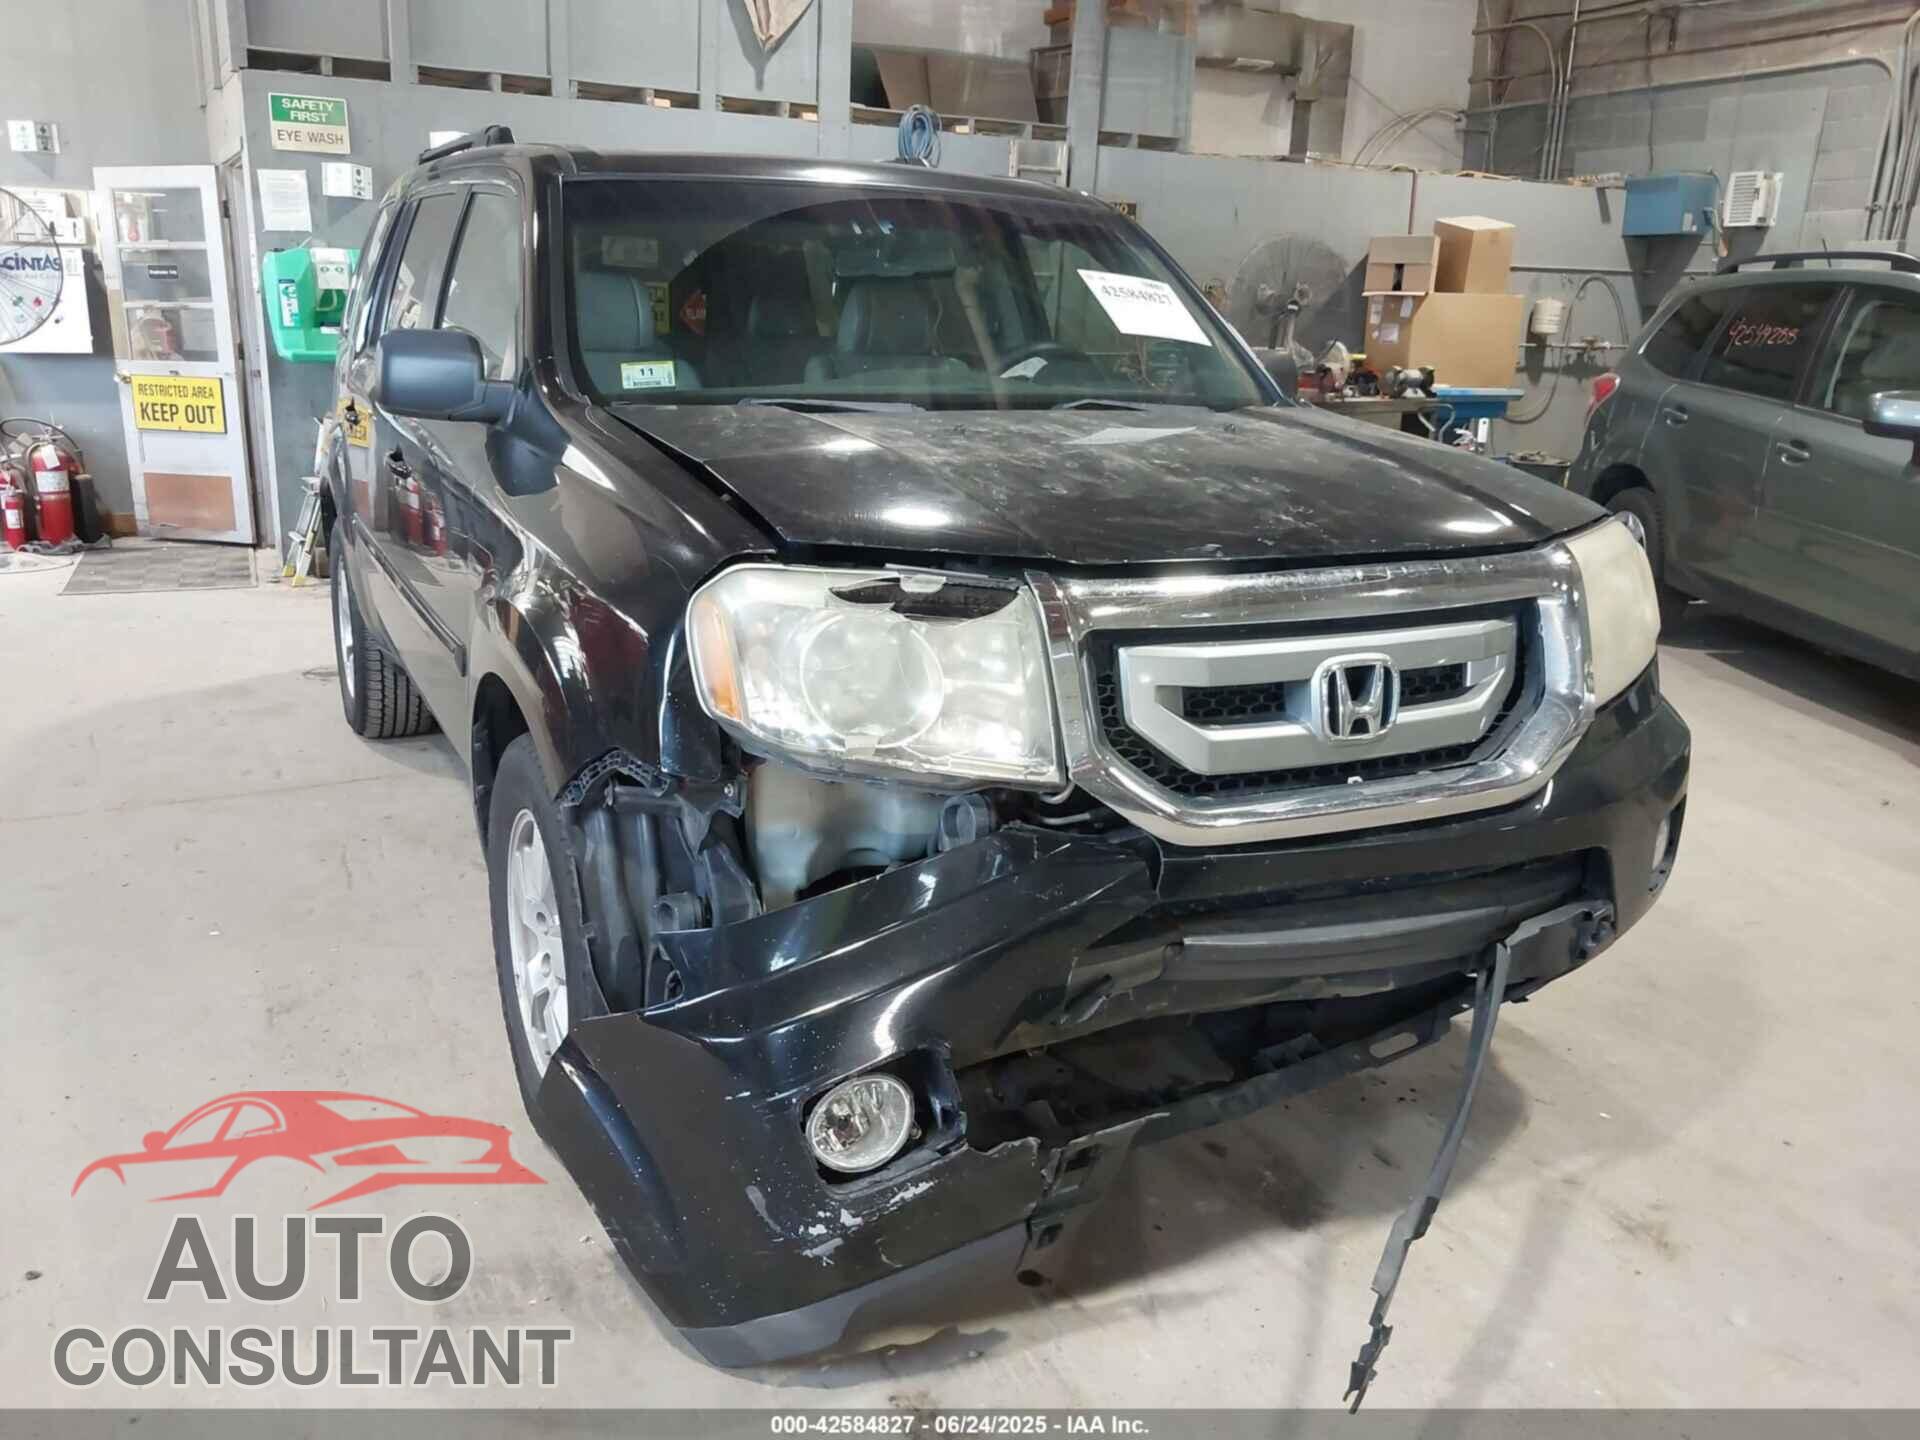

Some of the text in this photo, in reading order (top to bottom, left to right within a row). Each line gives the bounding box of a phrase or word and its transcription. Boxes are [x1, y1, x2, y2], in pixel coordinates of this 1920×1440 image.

[281, 98, 335, 112] SAFETY
[290, 110, 329, 123] FIRST
[276, 128, 345, 145] EYE WASH
[639, 367, 655, 377] 11
[137, 383, 215, 400] RESTRICTED AREA
[139, 402, 216, 425] KEEP OUT
